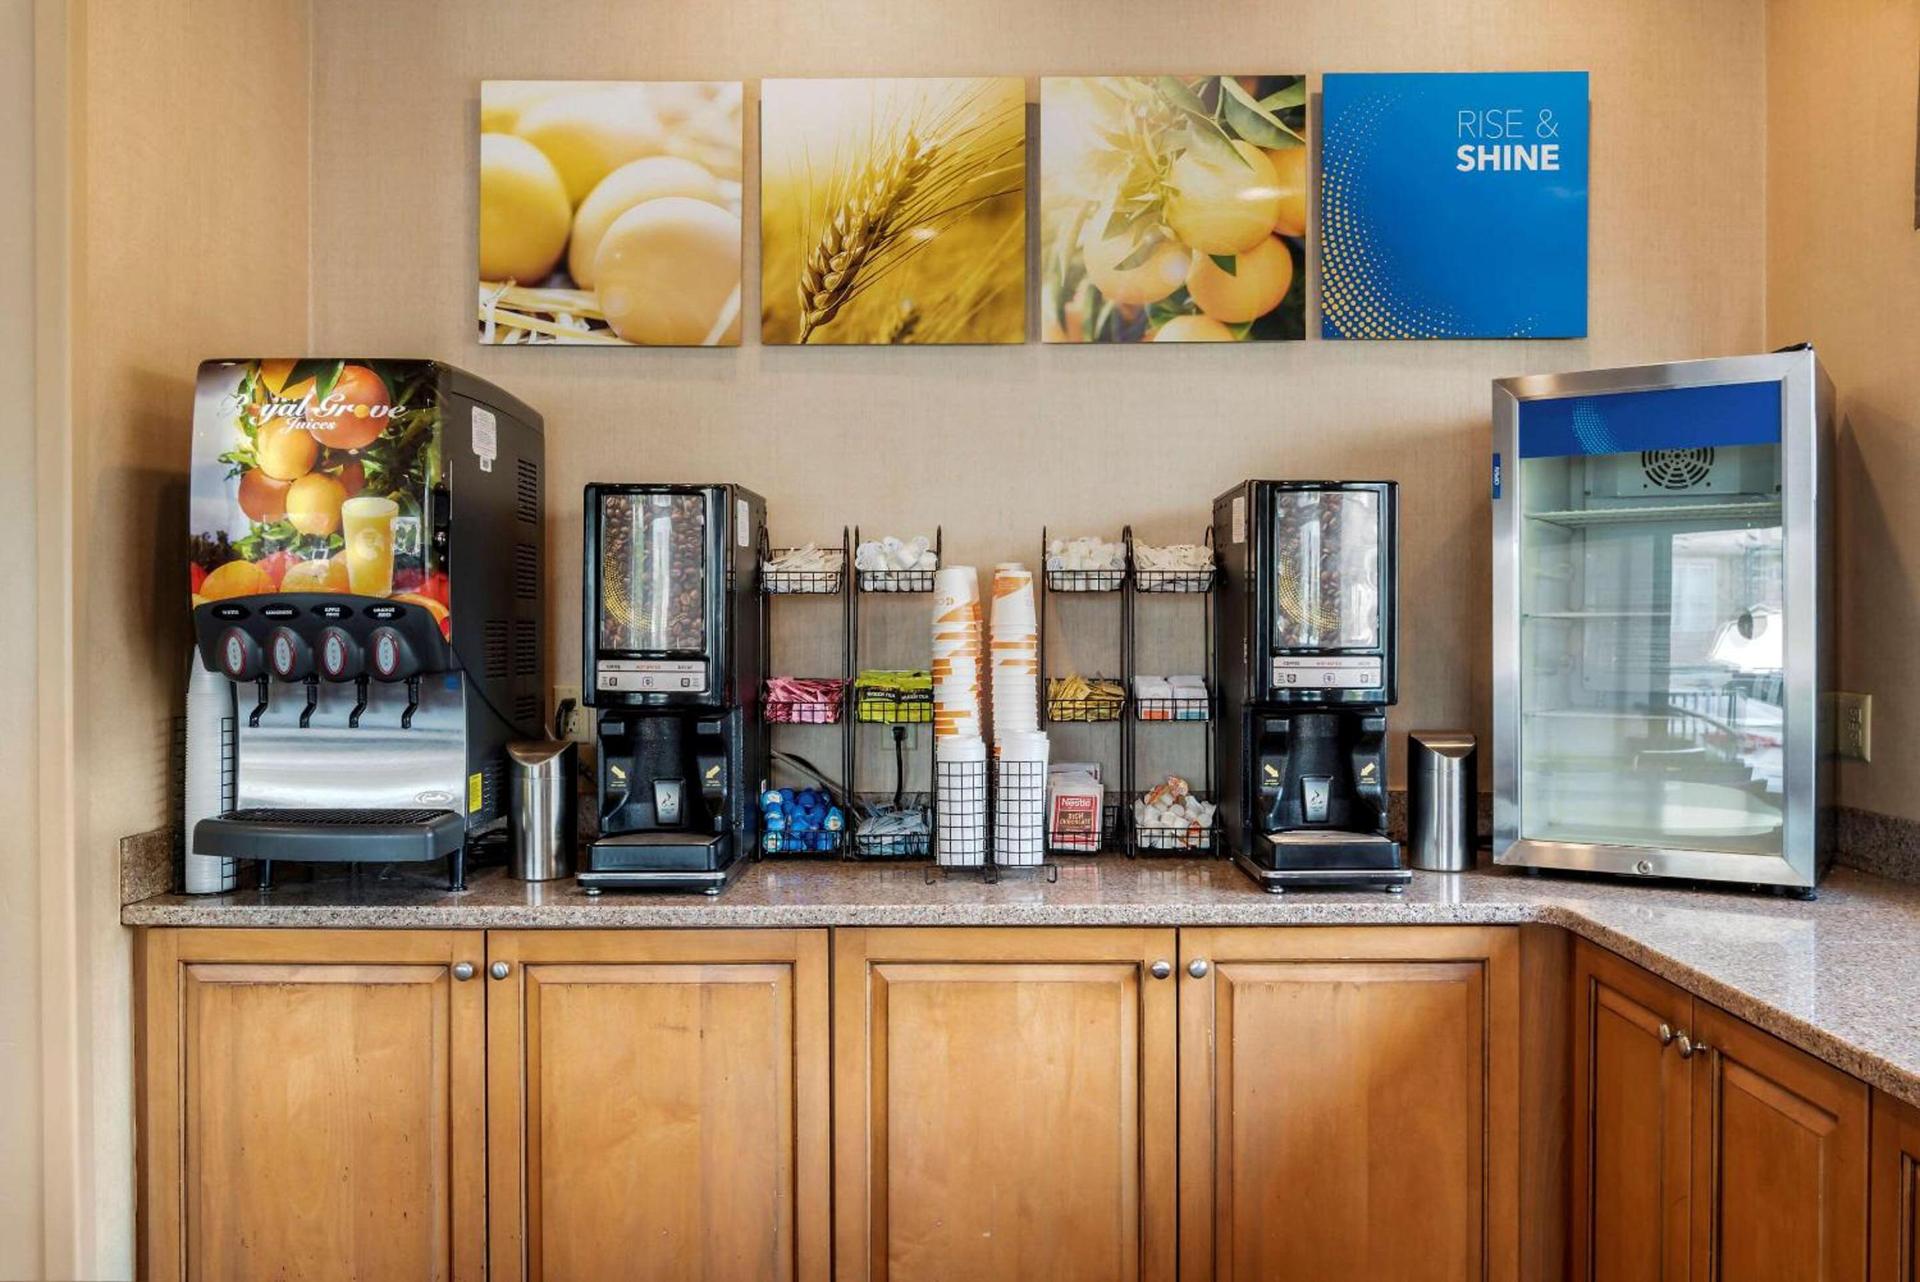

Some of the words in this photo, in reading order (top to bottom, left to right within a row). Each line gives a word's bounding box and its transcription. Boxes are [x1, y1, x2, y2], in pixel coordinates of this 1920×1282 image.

[1457, 109, 1524, 139] RISE
[1536, 108, 1559, 138] &
[1456, 144, 1560, 172] SHINE
[311, 393, 410, 419] Grove
[286, 416, 337, 433] Juices
